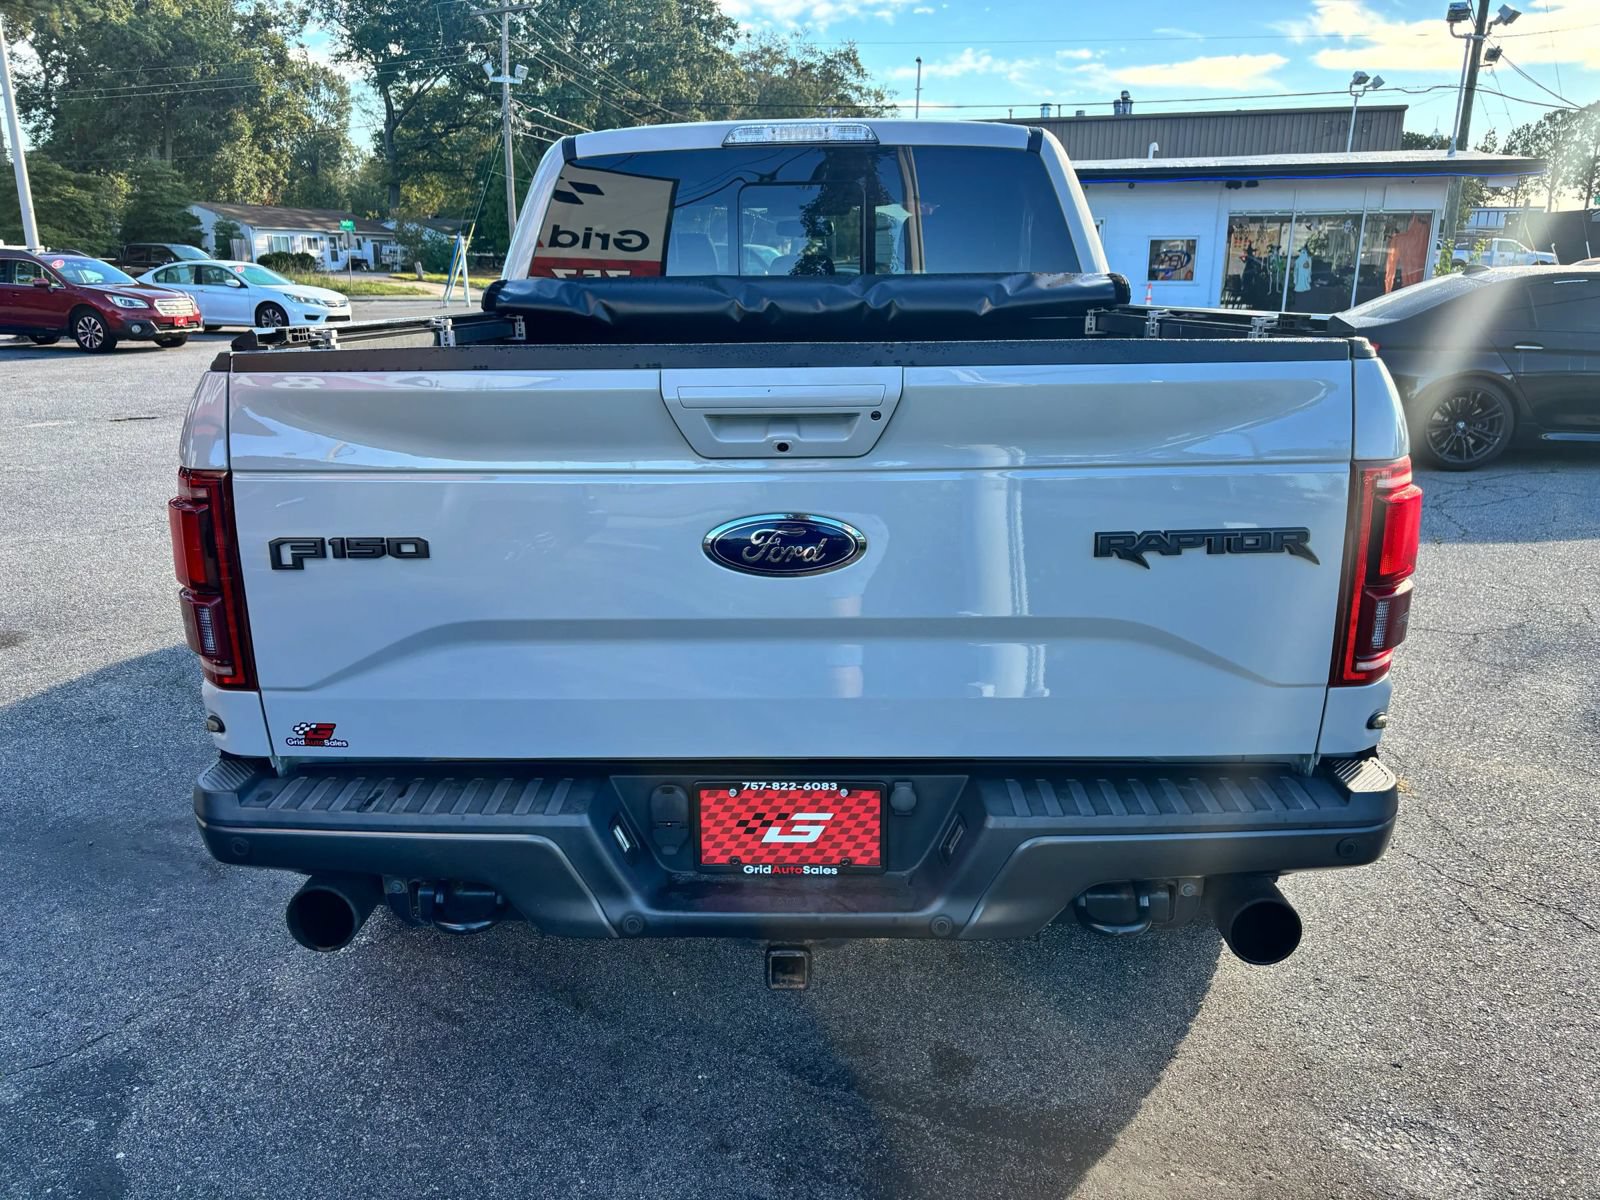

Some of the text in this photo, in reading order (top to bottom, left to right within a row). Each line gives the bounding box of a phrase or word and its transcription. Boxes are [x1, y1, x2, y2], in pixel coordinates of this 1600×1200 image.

[741, 528, 829, 563] Ford
[1093, 527, 1321, 570] RAPTOR
[741, 781, 838, 791] 757-822-6083
[743, 864, 838, 875] GridAutoSales
